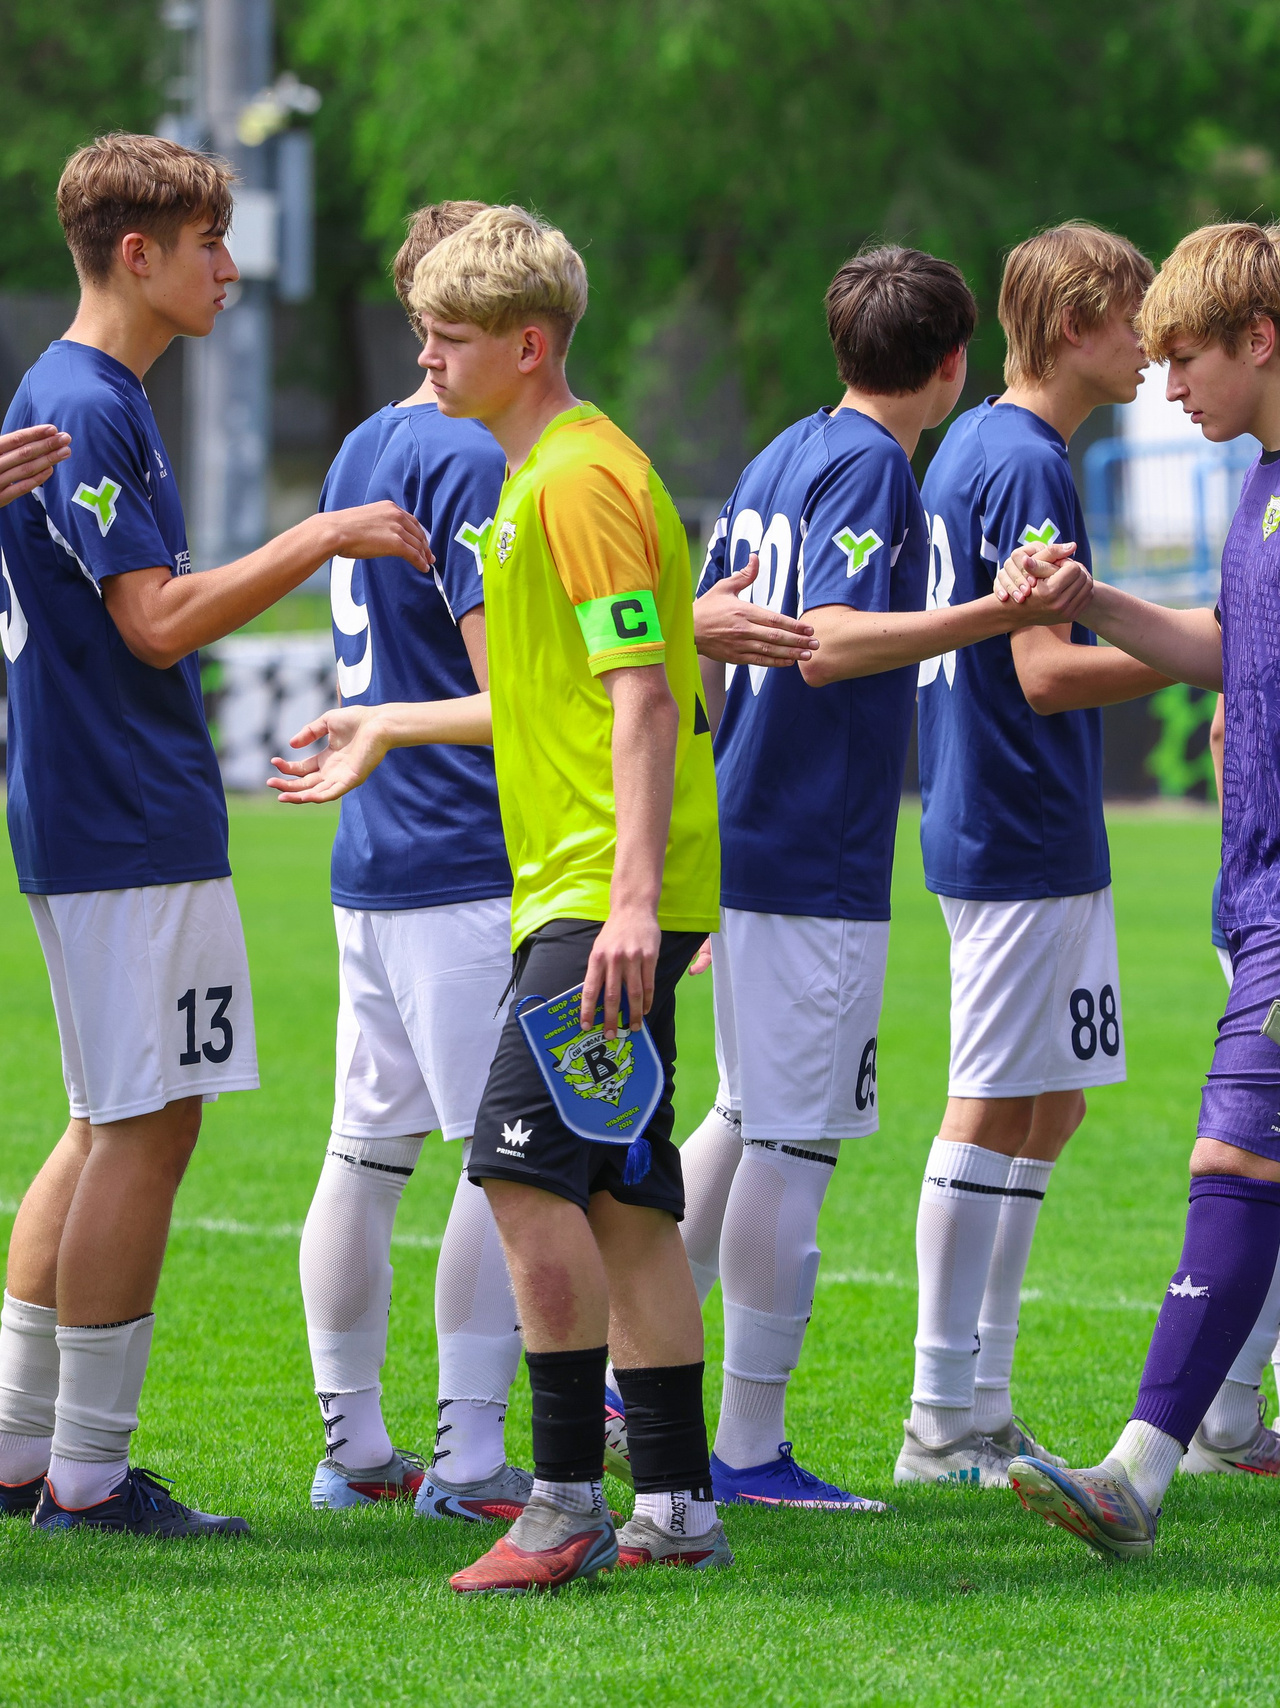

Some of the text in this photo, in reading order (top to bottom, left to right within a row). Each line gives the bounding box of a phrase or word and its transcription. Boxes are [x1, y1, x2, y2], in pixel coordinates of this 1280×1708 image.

[611, 599, 648, 639] C
[177, 985, 233, 1066] 13
[1069, 984, 1119, 1060] 88
[496, 1147, 525, 1159] PRIMERA
